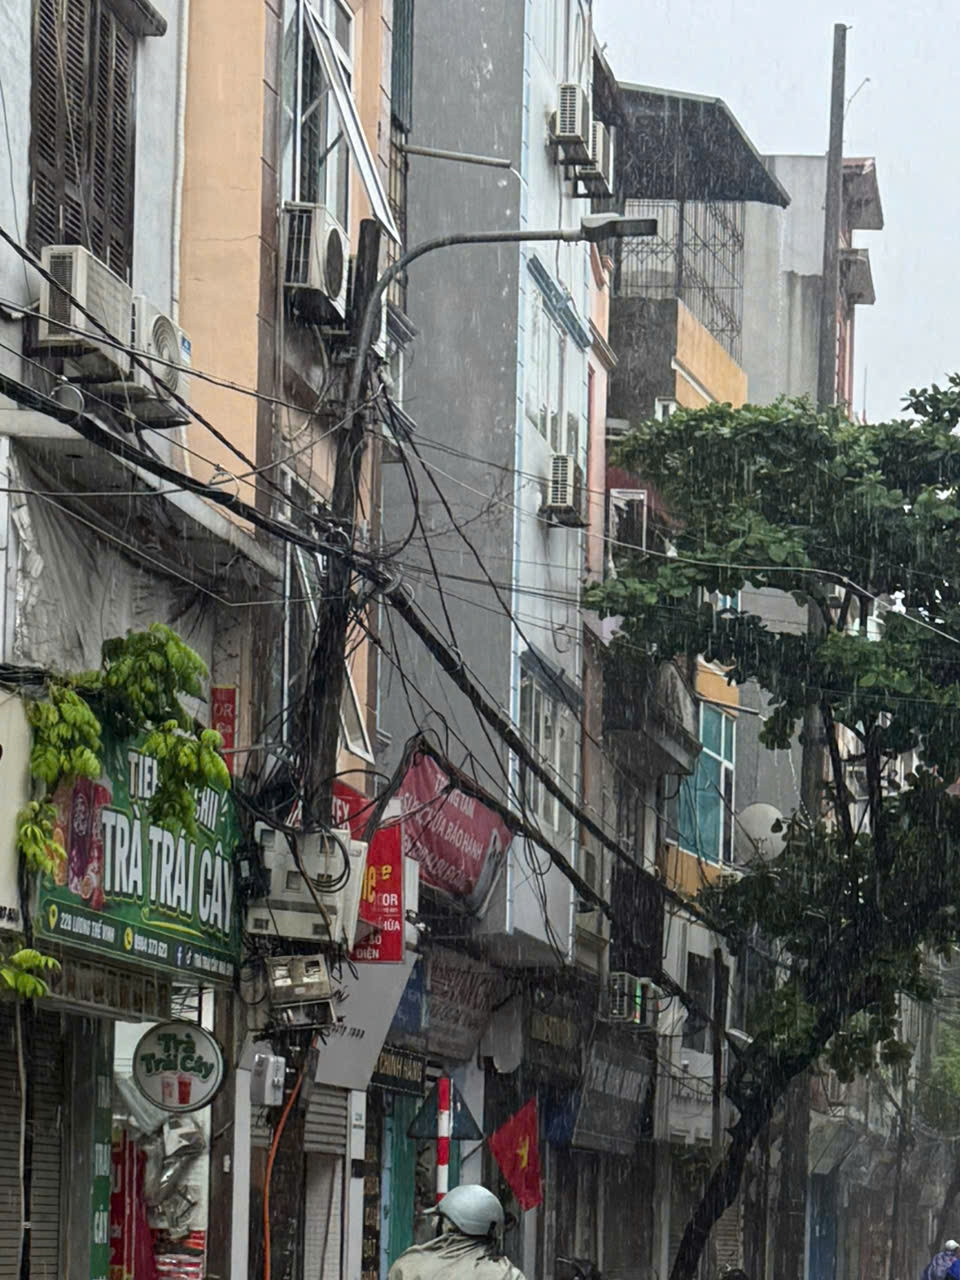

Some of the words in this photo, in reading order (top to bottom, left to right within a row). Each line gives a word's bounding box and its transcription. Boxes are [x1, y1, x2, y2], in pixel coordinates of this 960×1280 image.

[102, 804, 143, 897] TRÀ
[149, 826, 196, 916] TRÁI
[199, 841, 234, 934] CÂY
[158, 1033, 196, 1054] Trà
[180, 1054, 215, 1080] Cây
